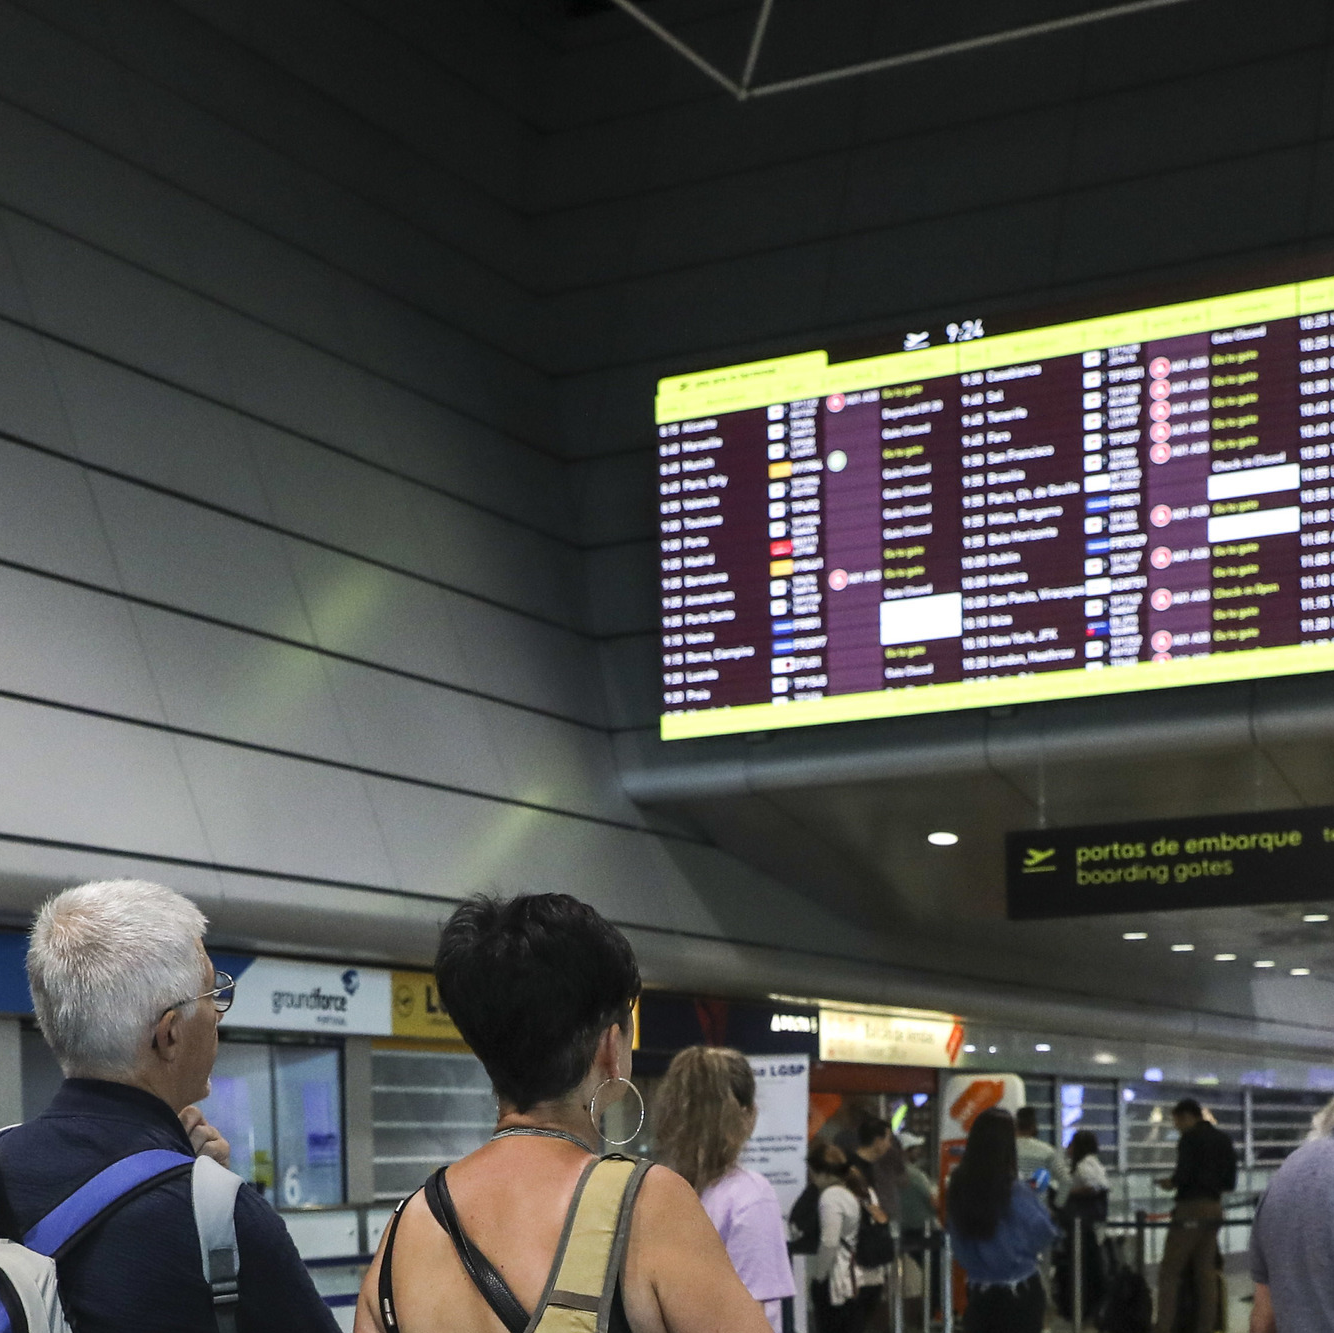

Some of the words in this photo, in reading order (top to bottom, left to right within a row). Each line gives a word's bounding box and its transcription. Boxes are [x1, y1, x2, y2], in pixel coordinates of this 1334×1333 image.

[946, 319, 985, 343] 9:24
[1076, 842, 1146, 867] portas
[1152, 836, 1180, 857] de
[1184, 830, 1302, 854] embarque
[1076, 861, 1169, 886] boarding
[1174, 859, 1234, 883] gates
[271, 987, 349, 1014] groundforce
[284, 1164, 303, 1206] 6
